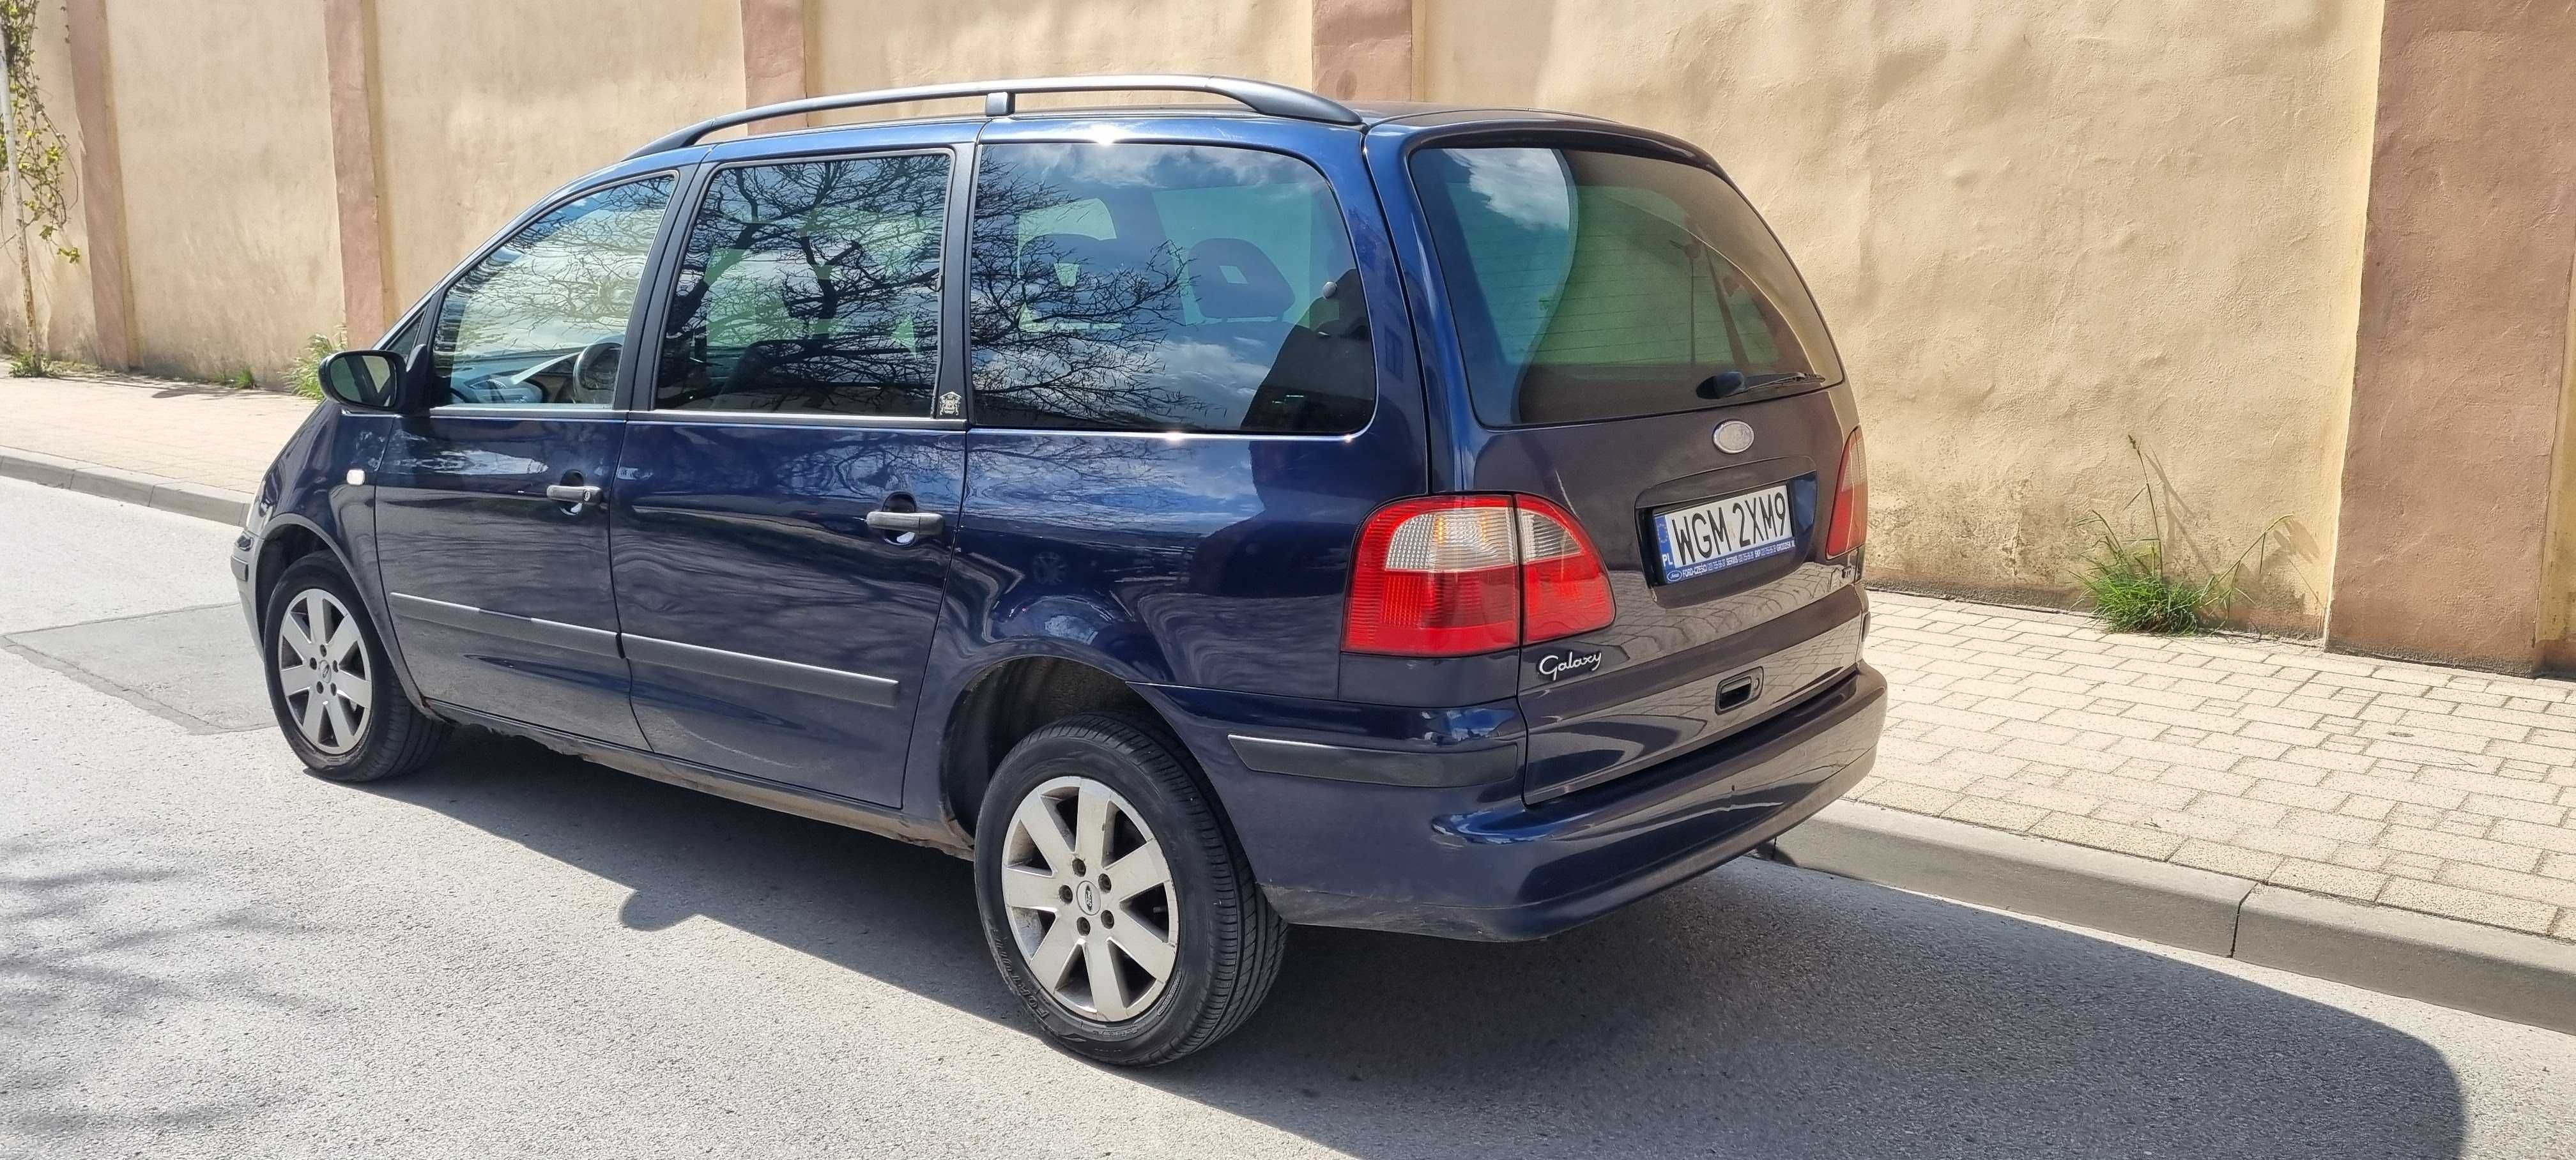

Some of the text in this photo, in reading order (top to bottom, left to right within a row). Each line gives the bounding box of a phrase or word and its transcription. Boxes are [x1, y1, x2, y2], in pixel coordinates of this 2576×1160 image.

[1671, 492, 1786, 565] WGM 2XM9
[1662, 554, 1673, 567] PL
[1539, 651, 1602, 681] Galaxy
